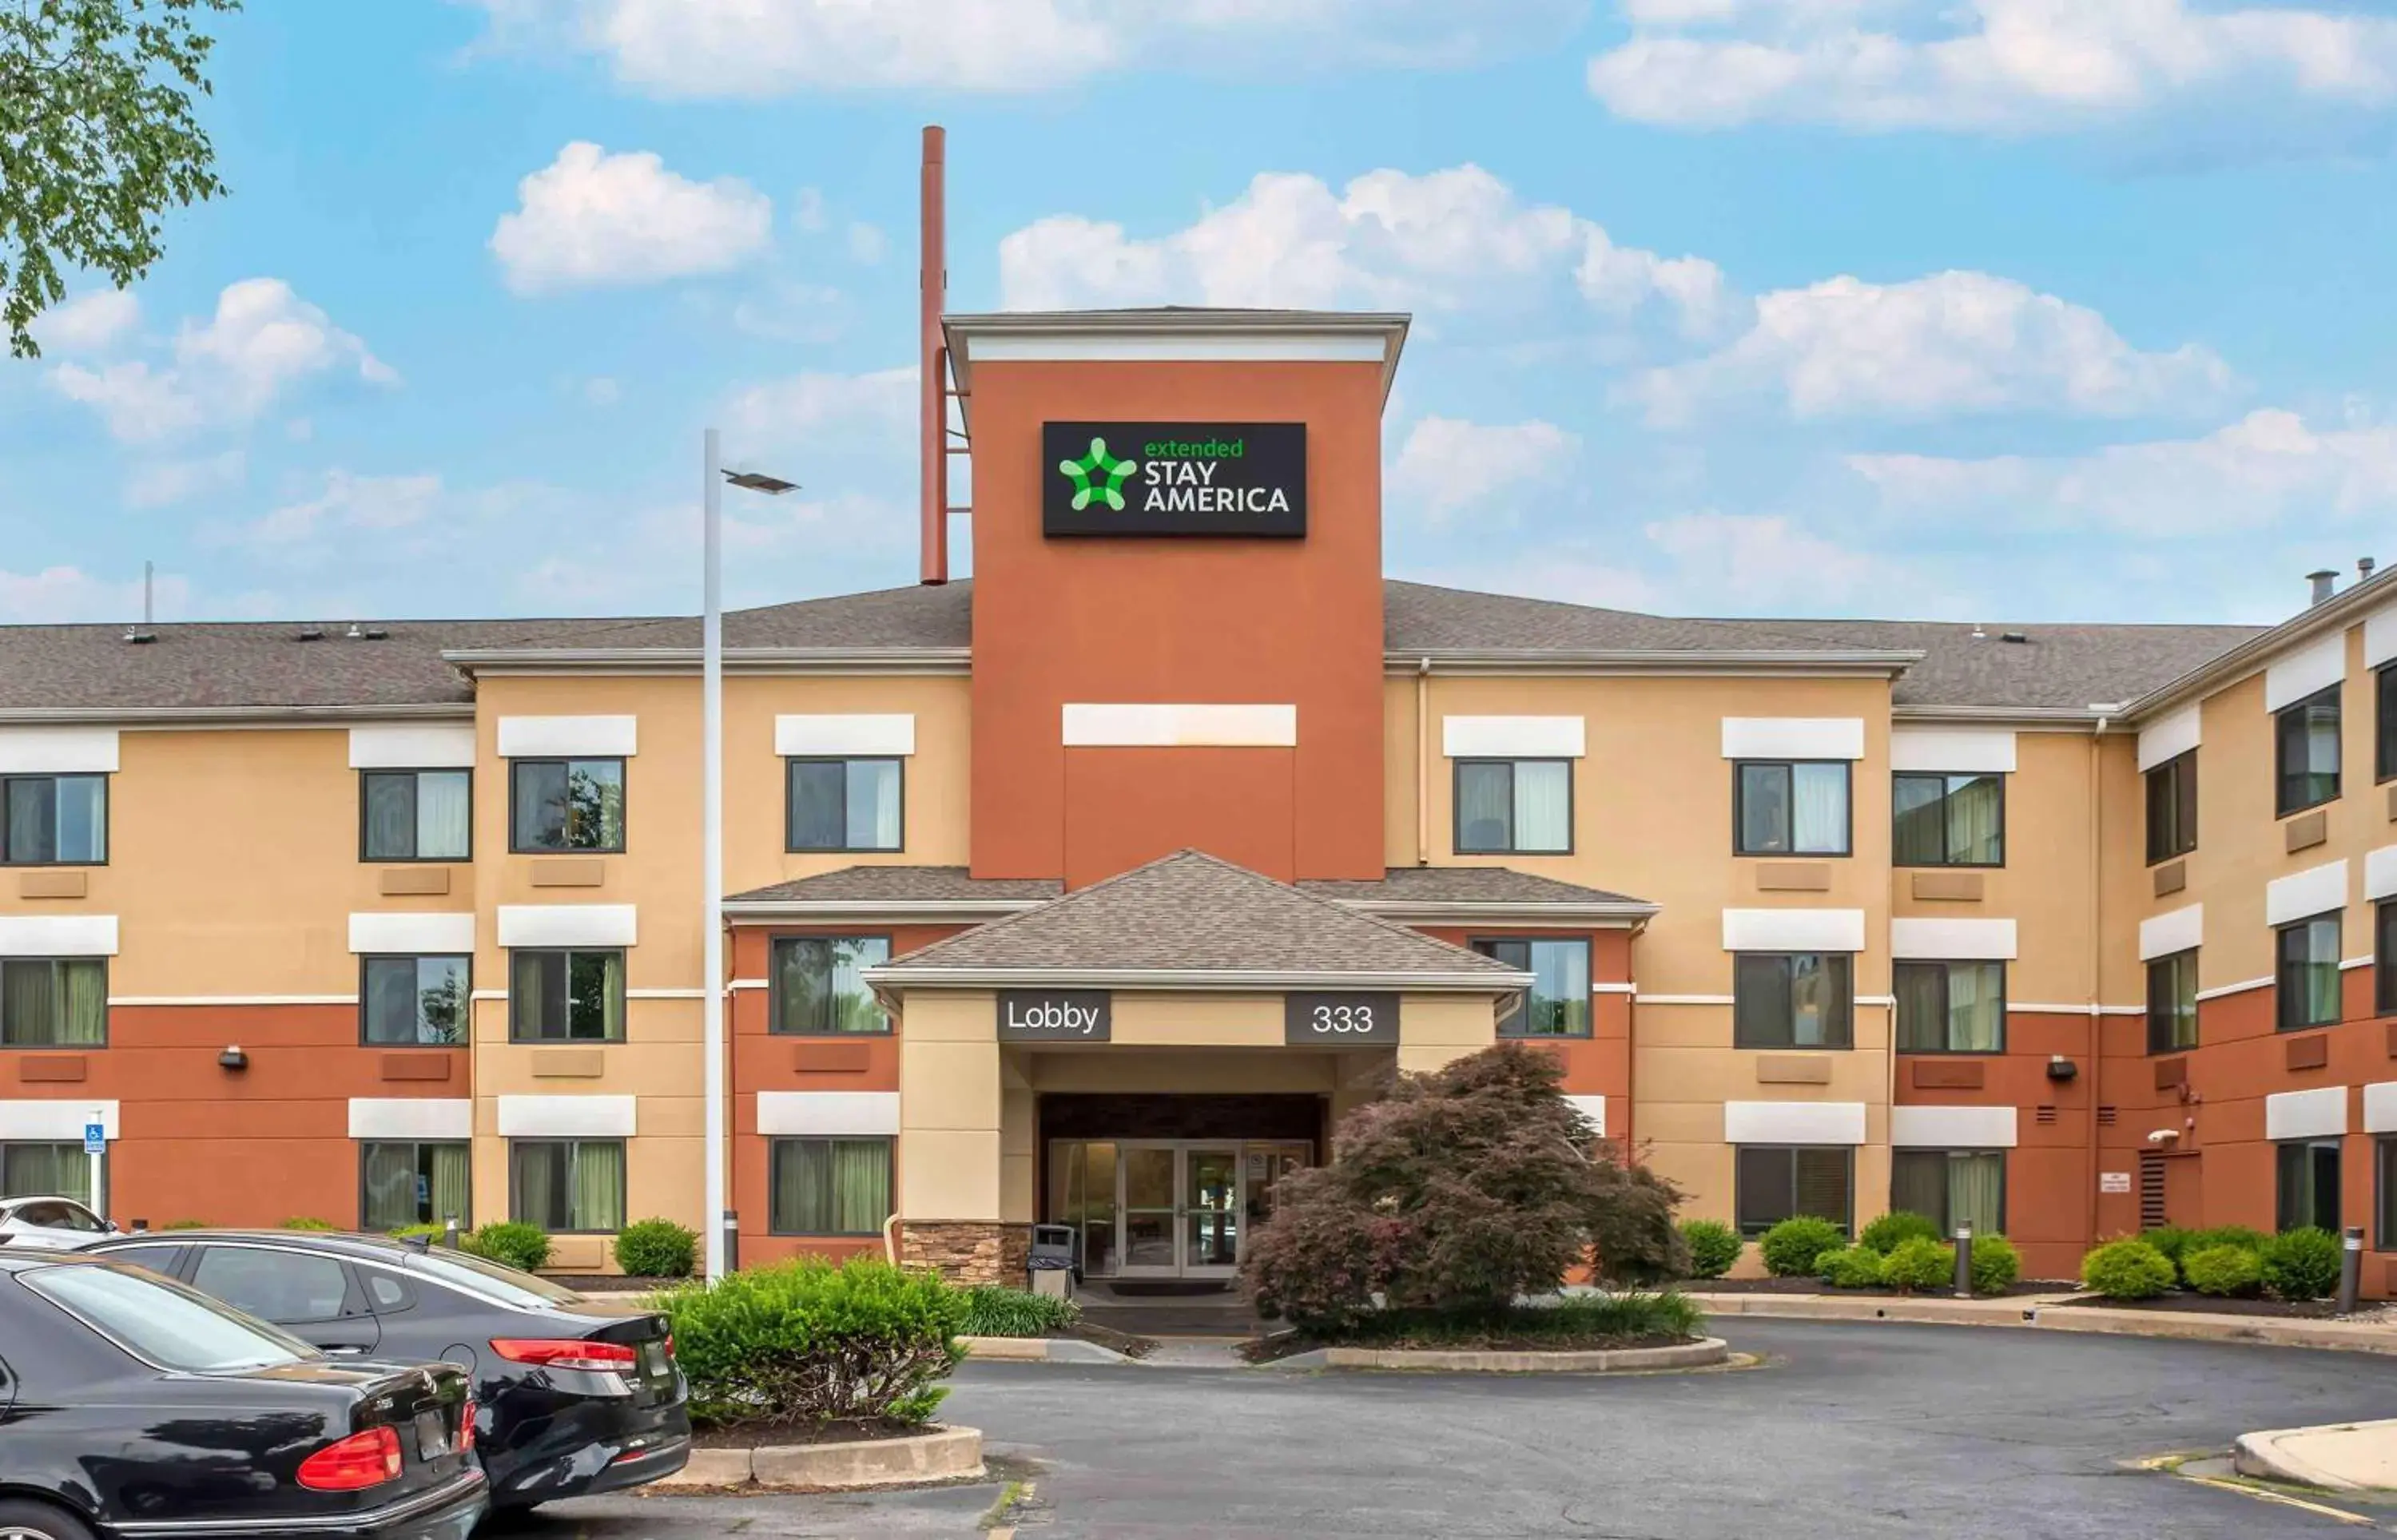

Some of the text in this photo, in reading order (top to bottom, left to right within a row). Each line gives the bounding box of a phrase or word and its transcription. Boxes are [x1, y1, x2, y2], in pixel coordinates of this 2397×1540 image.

[1144, 439, 1243, 458] extended
[1144, 461, 1217, 486] STAY
[1143, 488, 1290, 512] AMERICA
[1008, 1002, 1099, 1034] Lobby
[1312, 1006, 1373, 1033] 333
